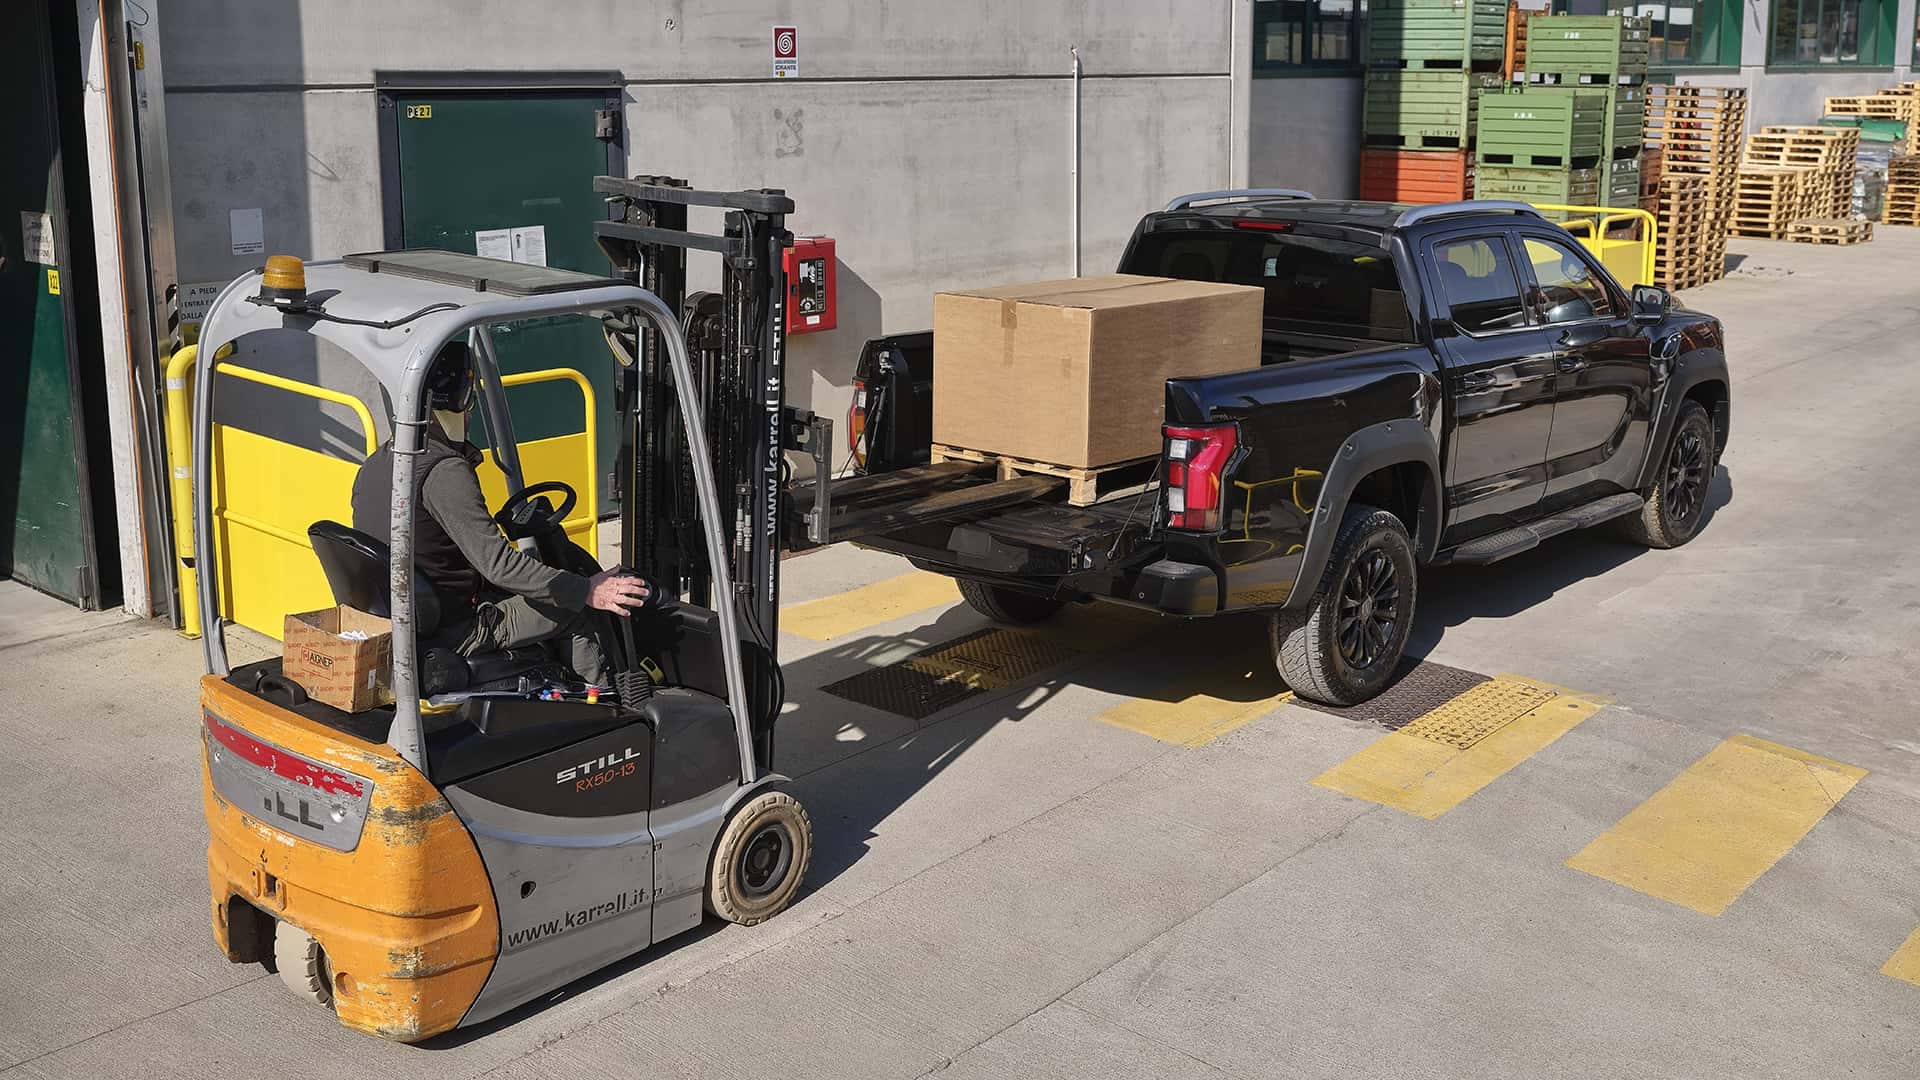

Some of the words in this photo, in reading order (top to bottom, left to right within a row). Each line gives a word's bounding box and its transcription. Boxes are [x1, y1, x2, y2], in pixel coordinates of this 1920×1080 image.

[408, 105, 430, 117] PE27
[200, 287, 217, 295] PIEDI
[182, 312, 203, 320] DALLA
[556, 747, 641, 784] STILL
[575, 761, 636, 793] RX50-13
